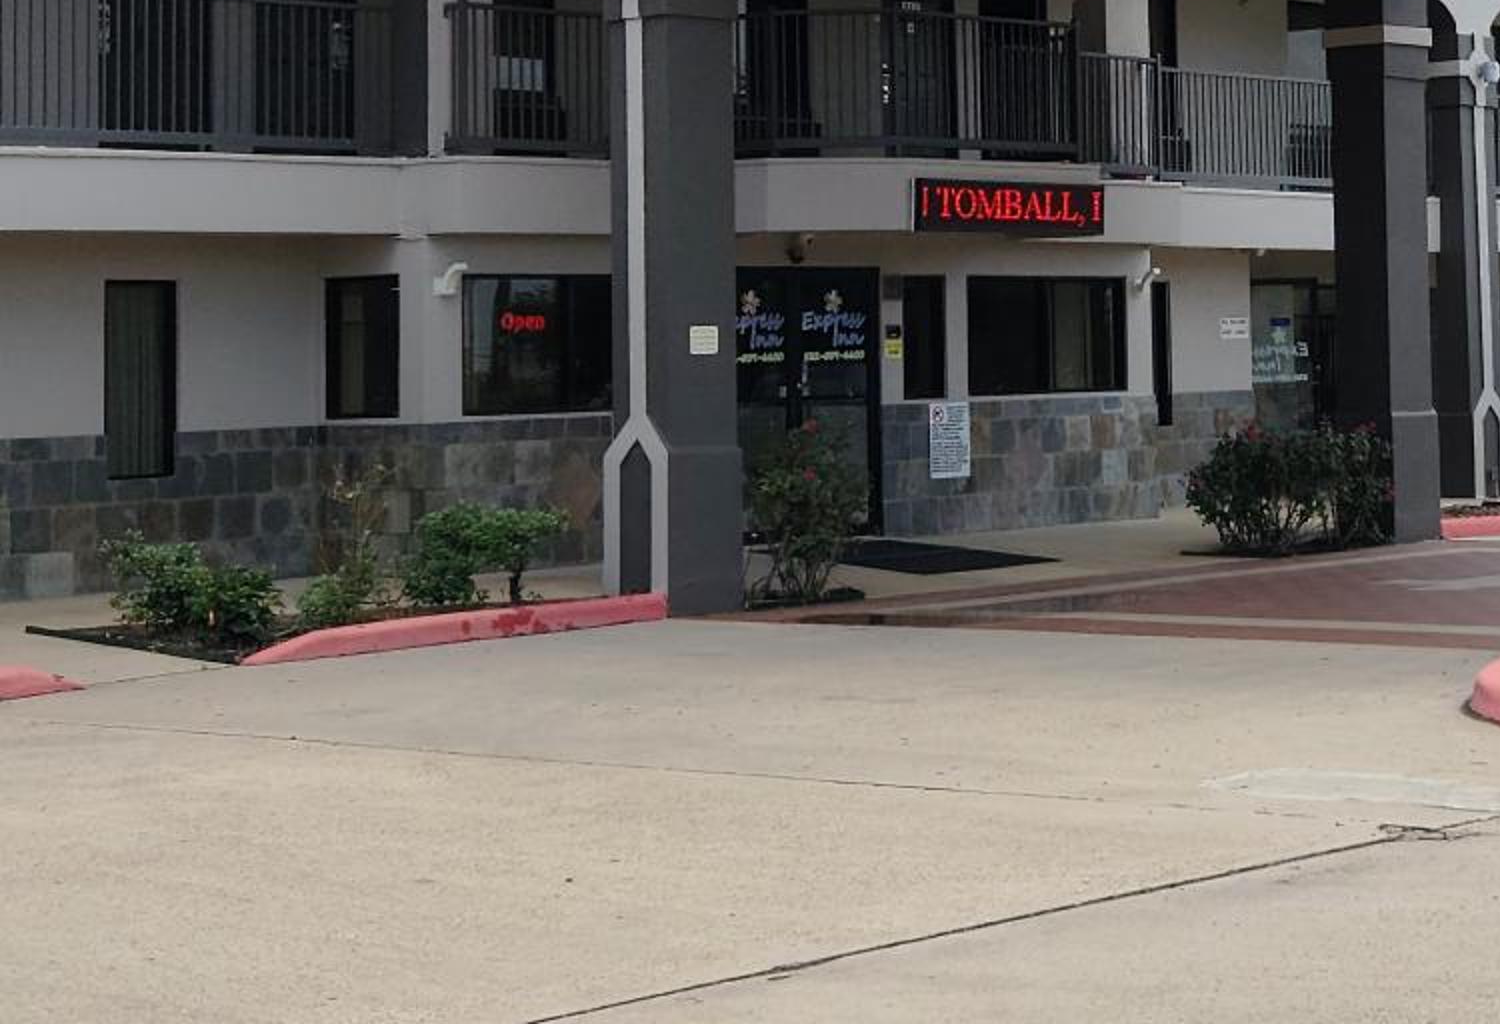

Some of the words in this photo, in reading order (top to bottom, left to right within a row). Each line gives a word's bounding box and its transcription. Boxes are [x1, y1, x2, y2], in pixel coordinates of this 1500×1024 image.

[936, 186, 1086, 226] TOMBALL,
[501, 312, 545, 333] Open
[801, 311, 866, 334] Express
[832, 330, 865, 348] Inn
